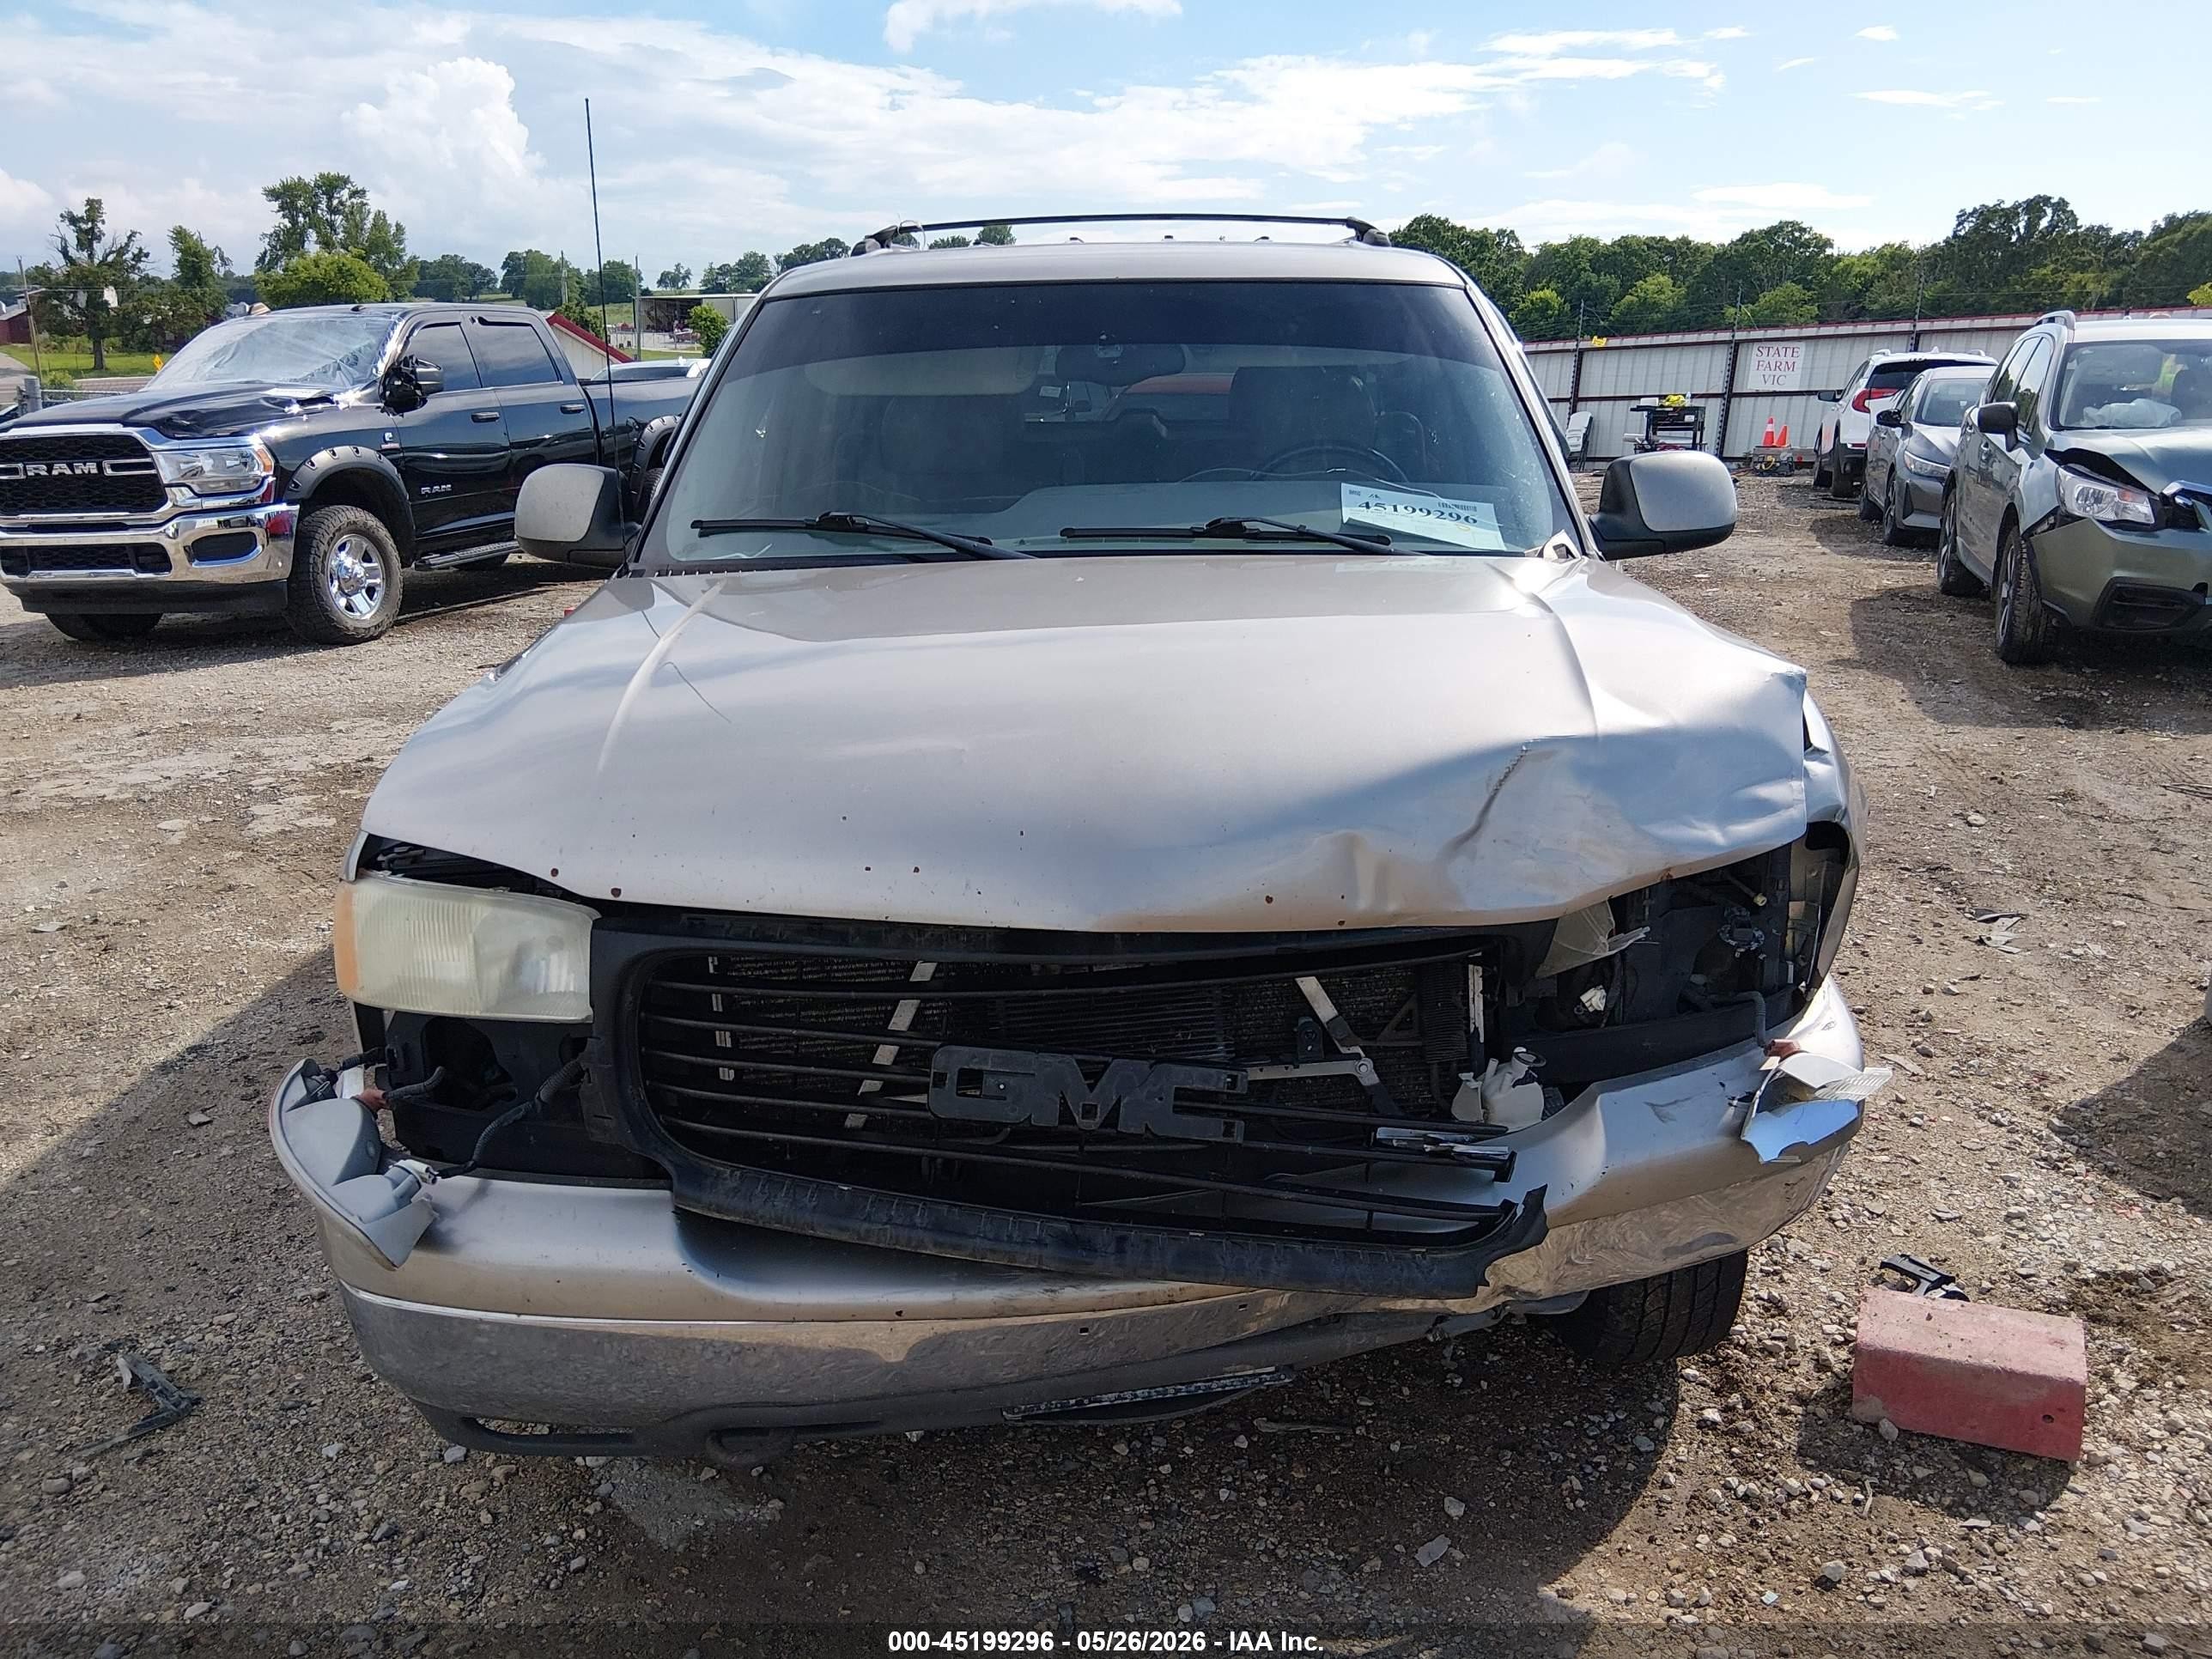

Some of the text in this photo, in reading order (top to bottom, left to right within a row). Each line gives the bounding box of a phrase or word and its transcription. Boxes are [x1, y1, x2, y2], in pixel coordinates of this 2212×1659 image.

[1756, 345, 1801, 358] STATE
[1756, 360, 1796, 372] FARM
[1762, 374, 1787, 386] VIC
[26, 462, 99, 477] RAM
[421, 484, 453, 495] RAM
[1358, 501, 1478, 524] 45199296
[927, 1044, 1249, 1145] GMC
